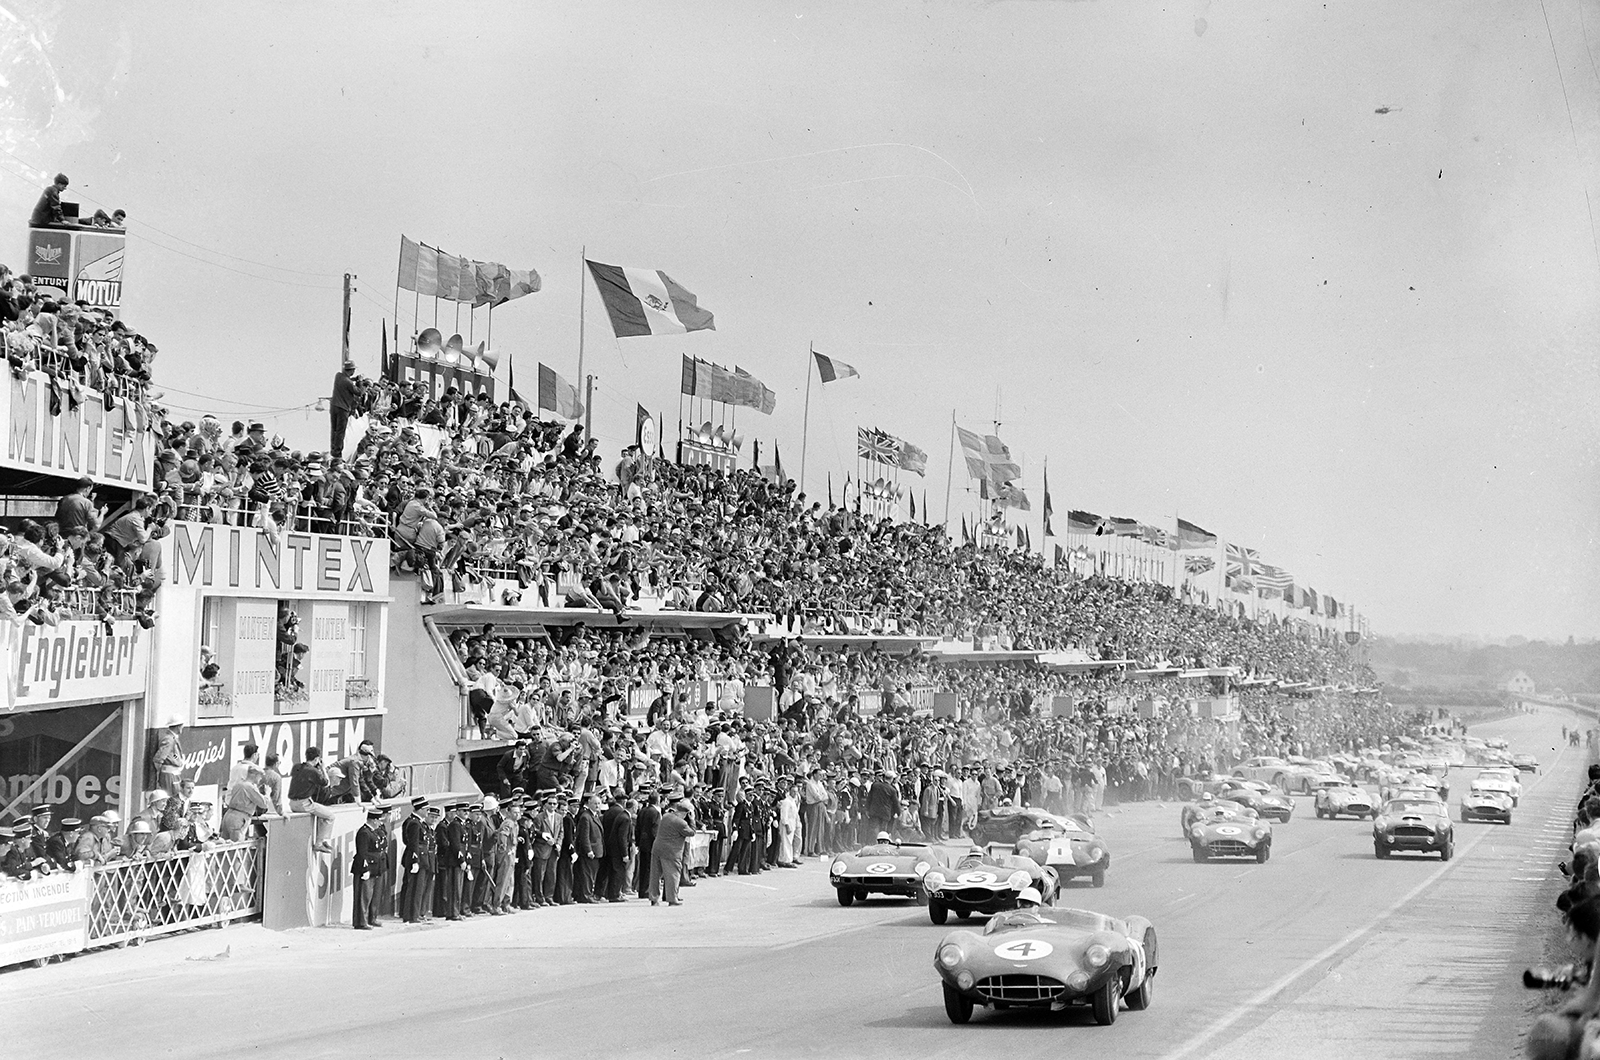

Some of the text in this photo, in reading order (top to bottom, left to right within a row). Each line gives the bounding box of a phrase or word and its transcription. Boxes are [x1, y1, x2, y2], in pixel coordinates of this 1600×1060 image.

[33, 276, 68, 286] ENTURY
[77, 280, 120, 305] MOTUL
[8, 377, 147, 485] MINTEX
[172, 524, 375, 593] MINTEX
[17, 624, 138, 698] Englebert
[181, 738, 226, 783] ougies
[870, 864, 893, 873] 8
[966, 873, 988, 884] 3
[33, 882, 70, 899] INCENDIE
[1007, 942, 1036, 957] 4
